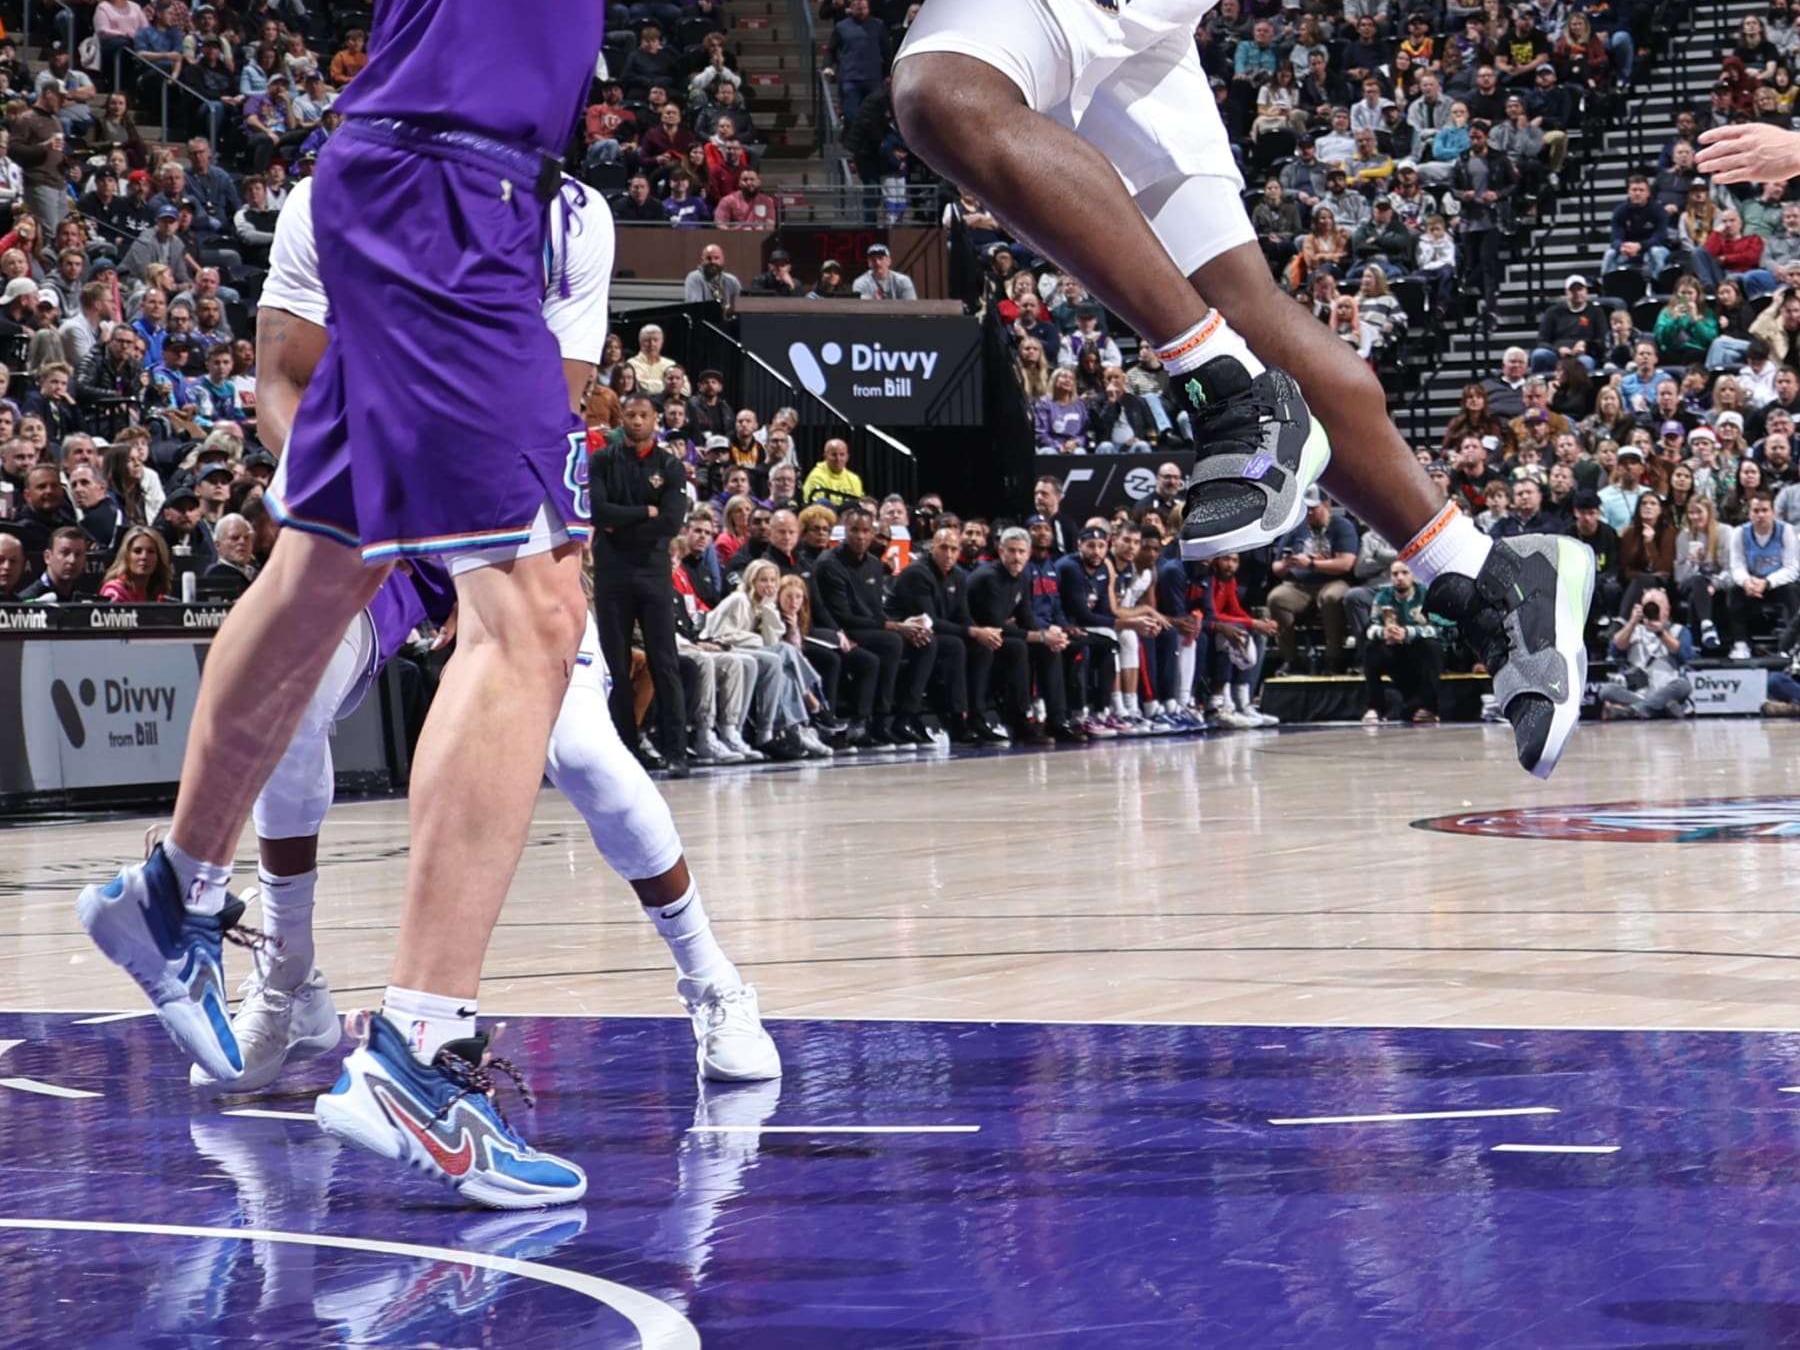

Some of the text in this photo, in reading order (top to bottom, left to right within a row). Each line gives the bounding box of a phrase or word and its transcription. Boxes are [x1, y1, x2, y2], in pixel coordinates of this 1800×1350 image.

[851, 342, 938, 380] Divvy
[853, 384, 882, 398] from
[10, 608, 48, 629] vivint
[103, 608, 138, 628] vivint
[1694, 675, 1741, 694] Divvy
[104, 676, 176, 722] Divvy
[109, 730, 134, 747] from
